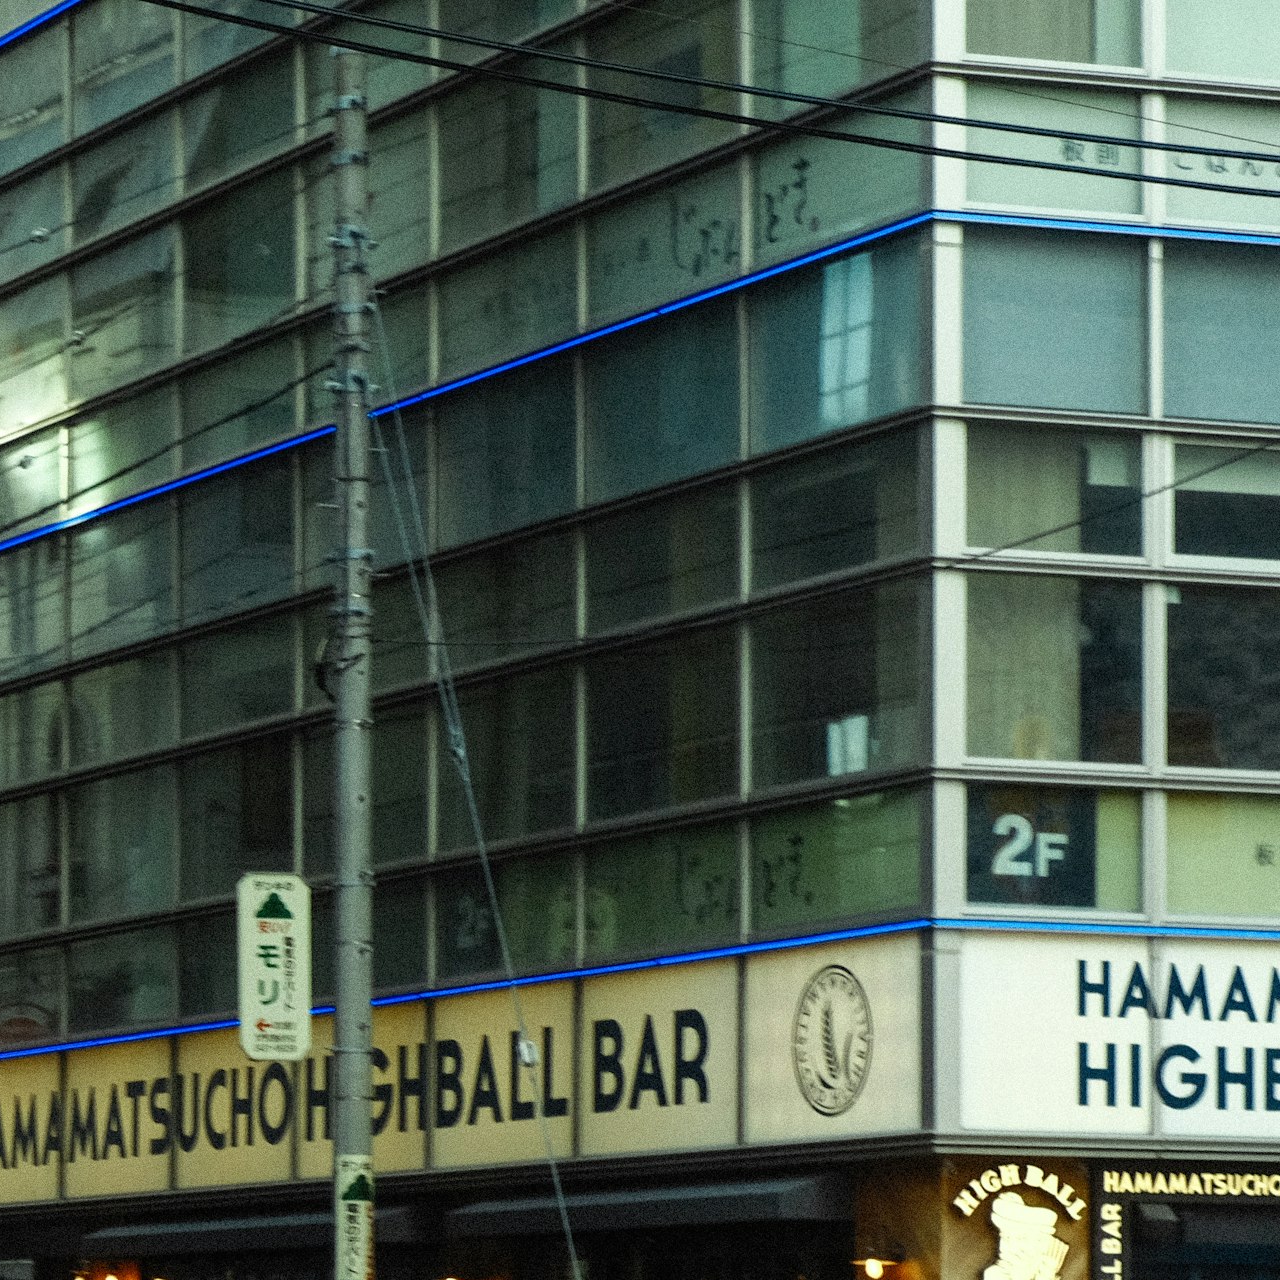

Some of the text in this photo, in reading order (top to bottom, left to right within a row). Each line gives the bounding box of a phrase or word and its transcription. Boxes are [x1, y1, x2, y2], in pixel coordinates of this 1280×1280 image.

[991, 814, 1069, 878] 2F
[1077, 959, 1280, 1023] HAMA
[305, 1022, 568, 1142] HGHBALL
[594, 1008, 708, 1114] BAR
[953, 1164, 1088, 1221] HIGH BALL
[1103, 1171, 1280, 1197] HAMAMATSUCHO
[1101, 1202, 1123, 1255] BAR
